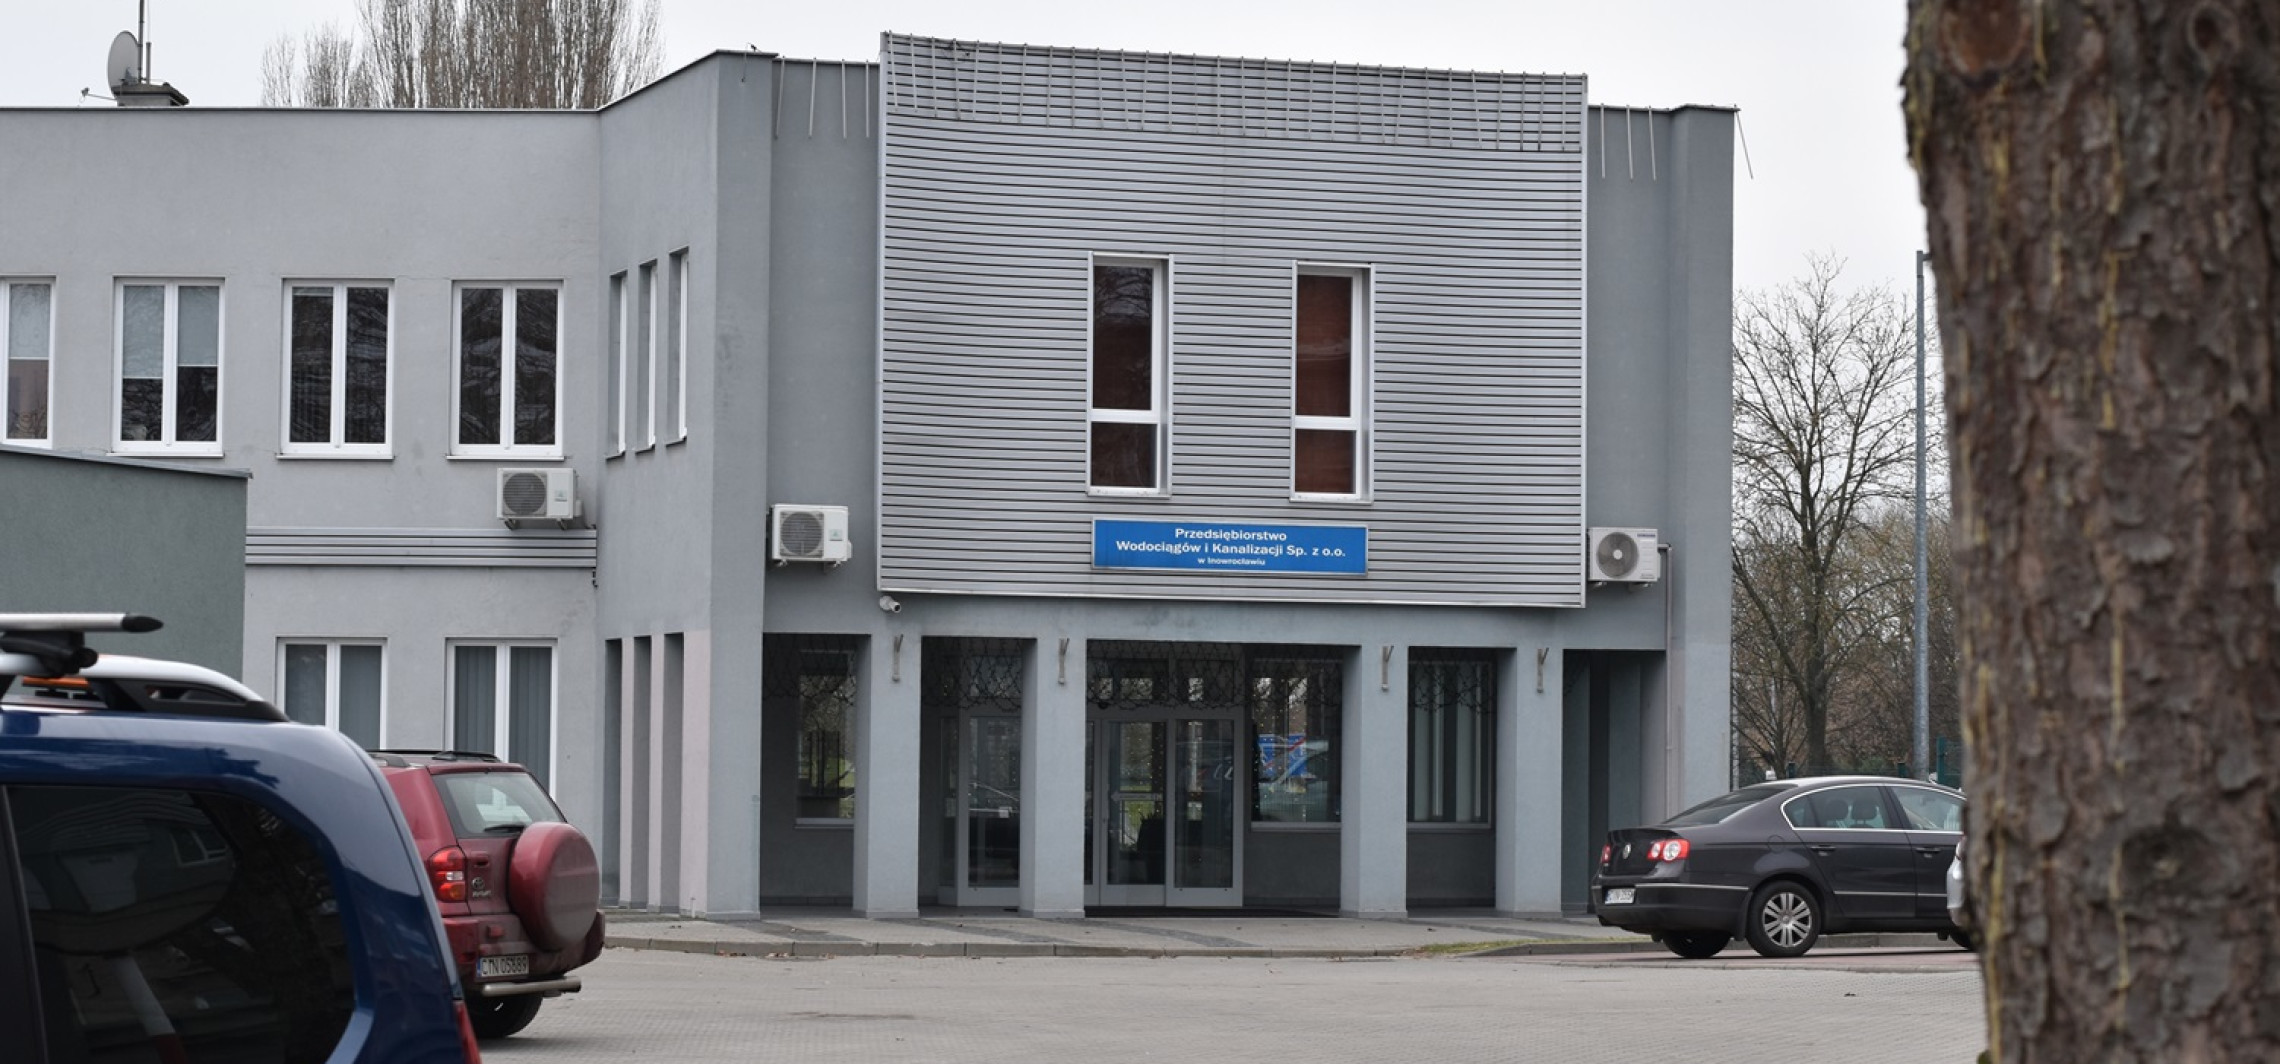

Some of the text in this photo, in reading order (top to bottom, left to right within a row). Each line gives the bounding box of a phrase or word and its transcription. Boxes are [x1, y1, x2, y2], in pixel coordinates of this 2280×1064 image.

[1175, 528, 1287, 541] Przedsiębiorstwo
[1116, 540, 1346, 557] Wodociągów i Kanalizacji Sp. z o.o.
